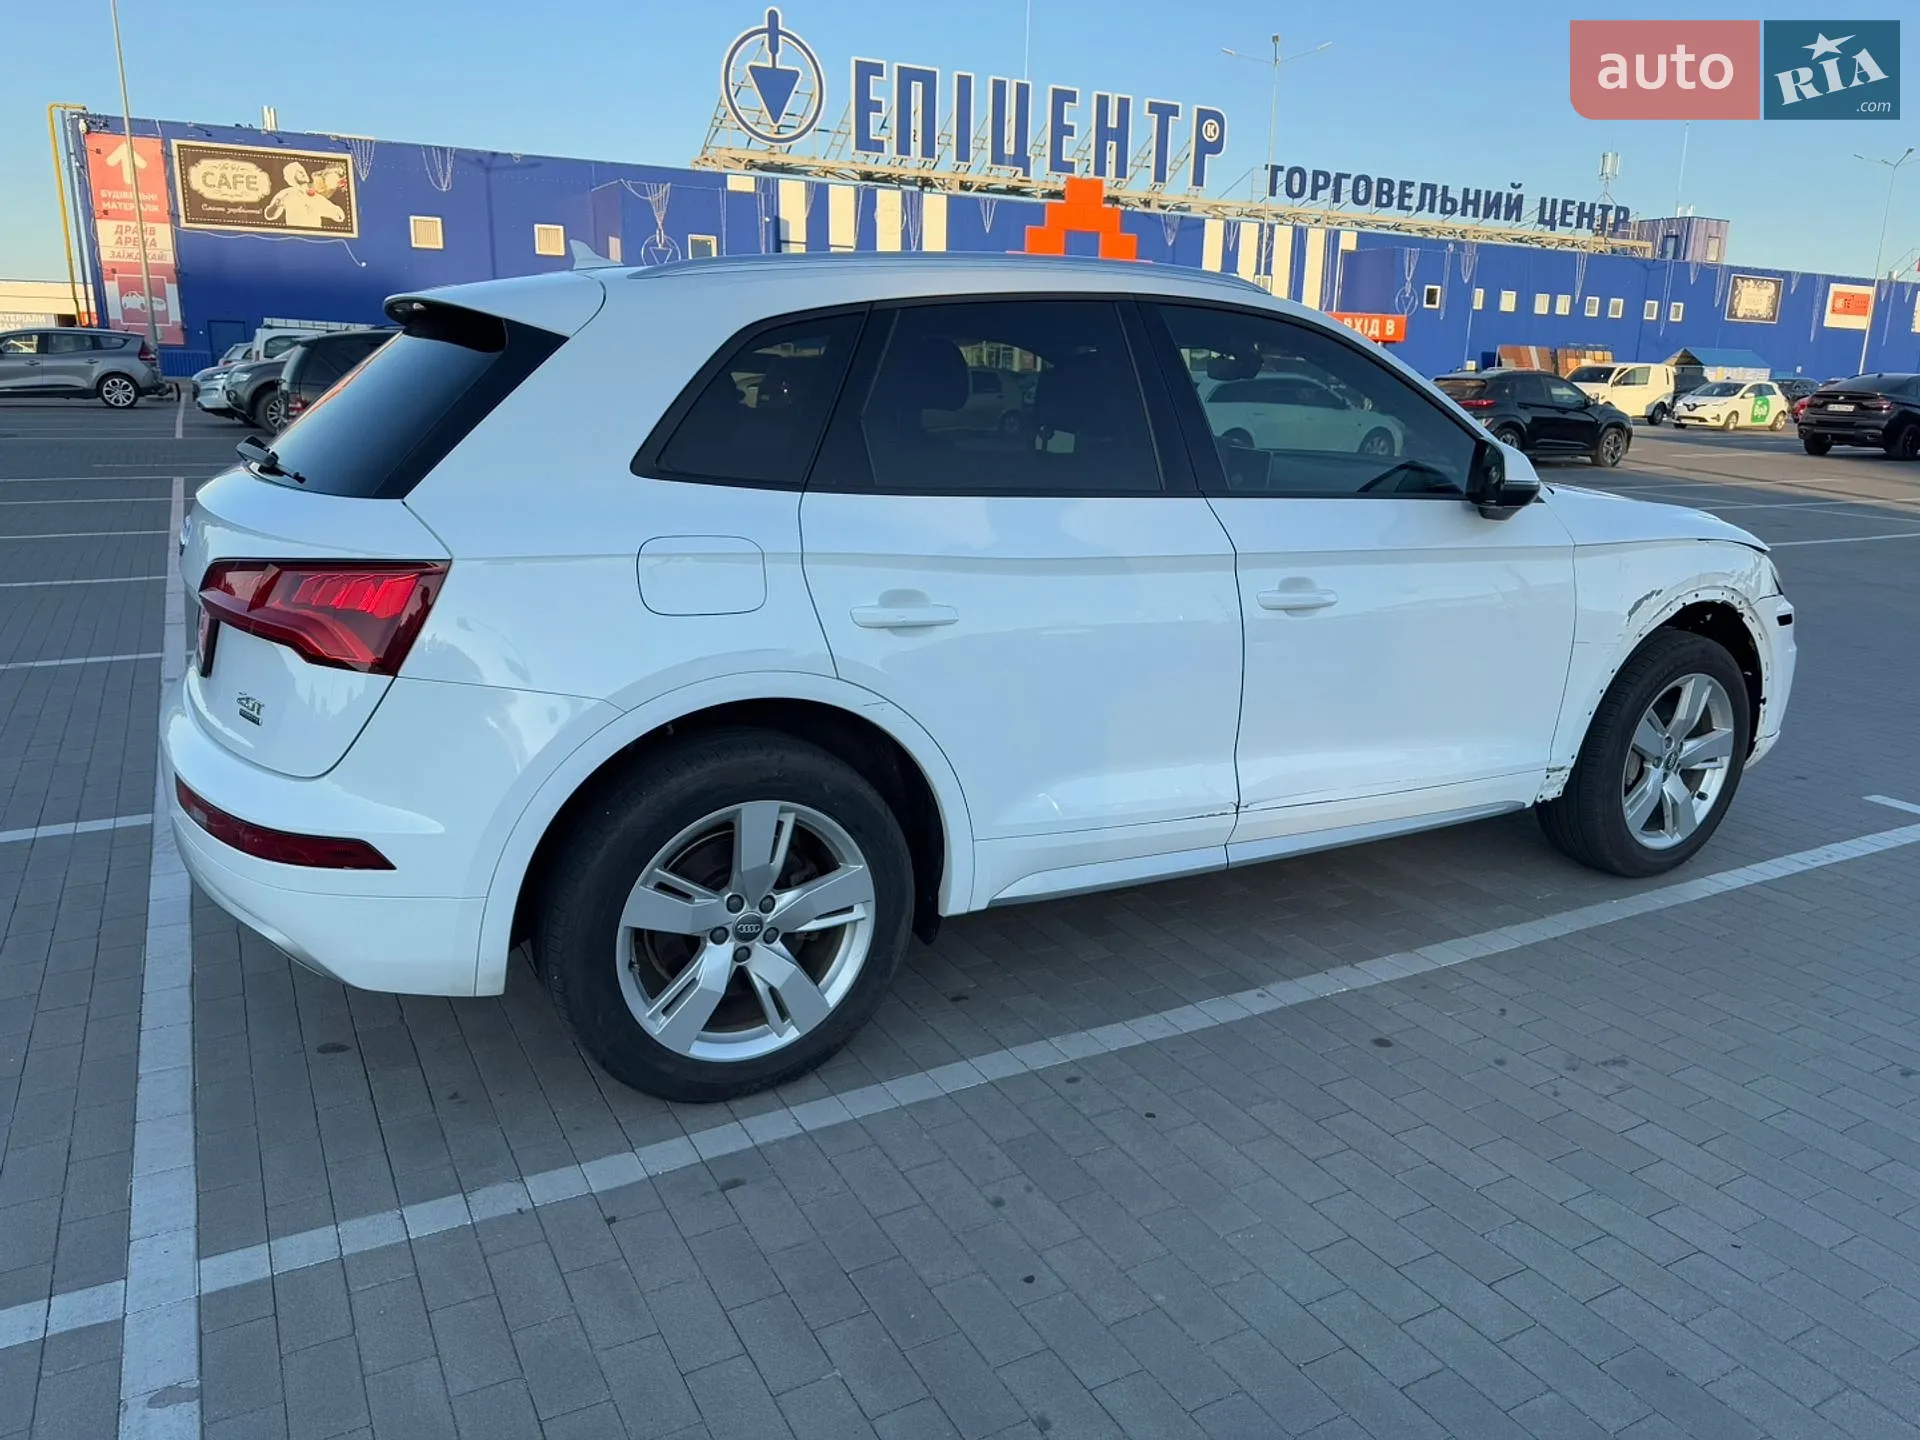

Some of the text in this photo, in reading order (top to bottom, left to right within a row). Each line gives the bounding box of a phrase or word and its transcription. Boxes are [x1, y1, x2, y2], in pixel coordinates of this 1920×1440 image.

[850, 56, 1227, 189] ЕПІЦЕНТР
[201, 171, 260, 192] CAFE
[1264, 163, 1632, 234] ТОРГОВЕЛЬНИЙ ЦЕНТР
